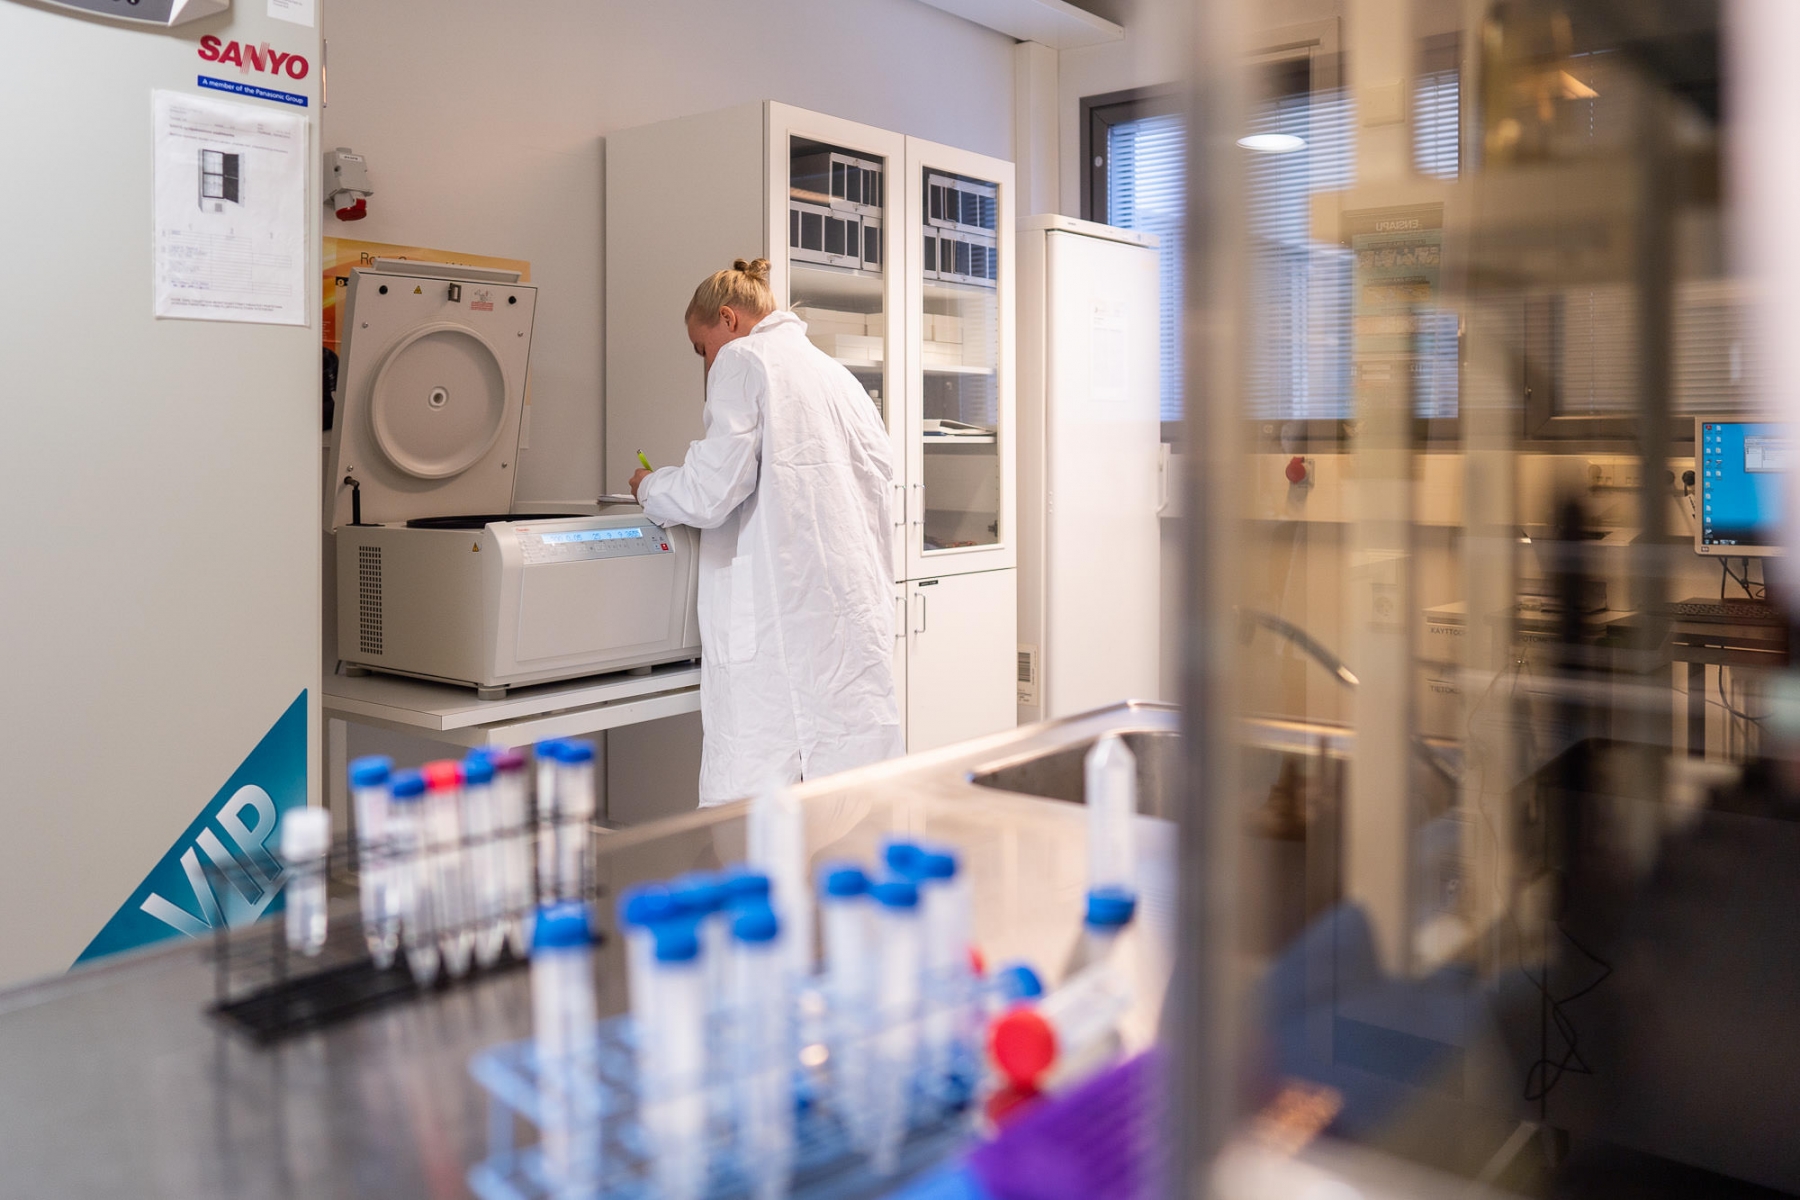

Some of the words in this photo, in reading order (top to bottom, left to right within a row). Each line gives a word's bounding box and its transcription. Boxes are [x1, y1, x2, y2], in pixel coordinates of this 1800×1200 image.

[197, 34, 309, 80] SANYO
[202, 78, 208, 86] A
[208, 80, 235, 91] member
[235, 84, 243, 92] of
[244, 86, 255, 94] the
[255, 88, 285, 101] Panasonic
[285, 94, 304, 105] Group
[139, 784, 284, 940] VIP
